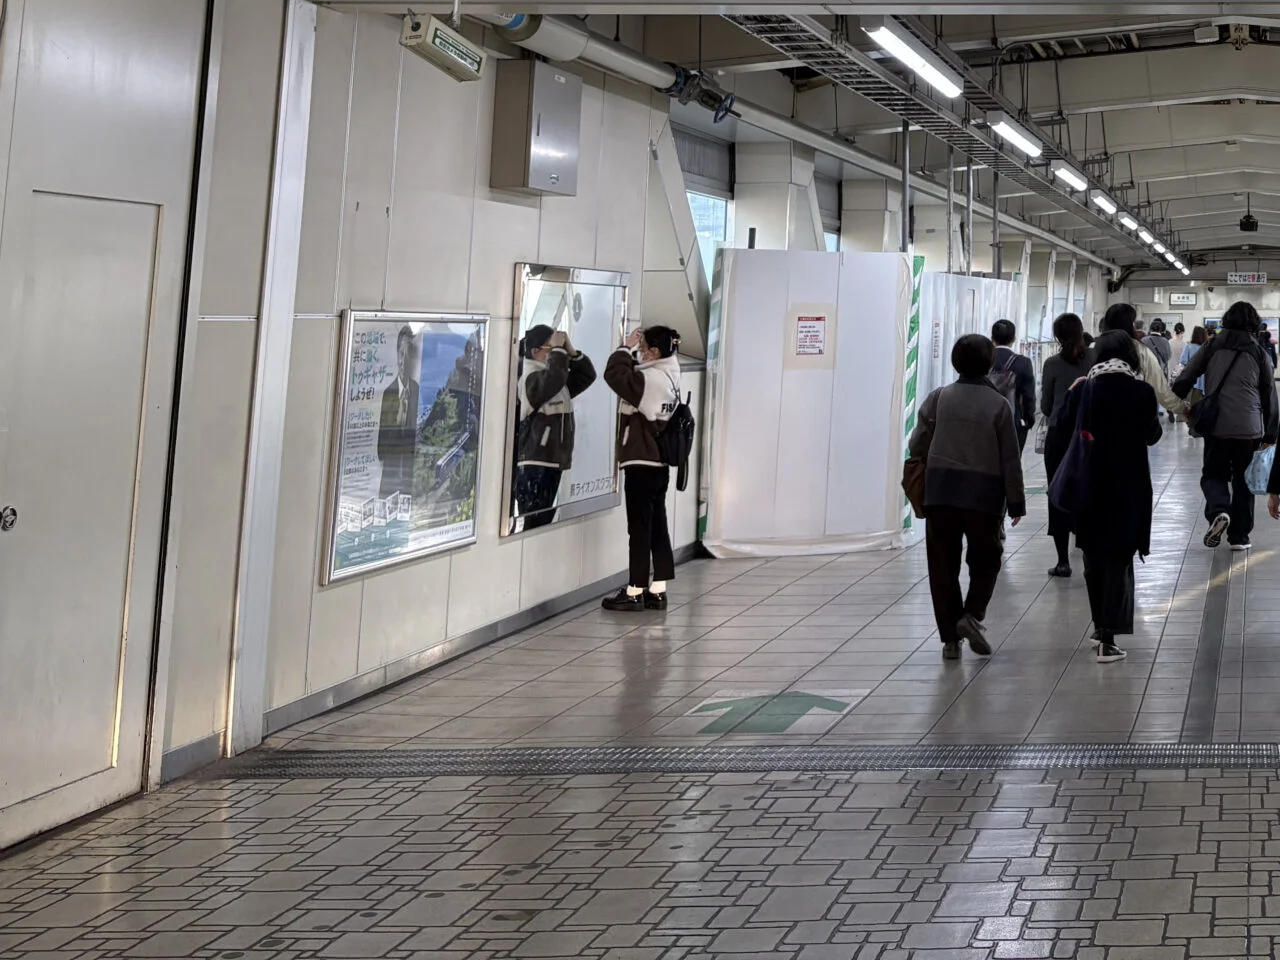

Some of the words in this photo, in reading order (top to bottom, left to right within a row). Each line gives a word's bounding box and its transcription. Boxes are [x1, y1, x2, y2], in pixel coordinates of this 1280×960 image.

[352, 364, 394, 385] トゥギャザー
